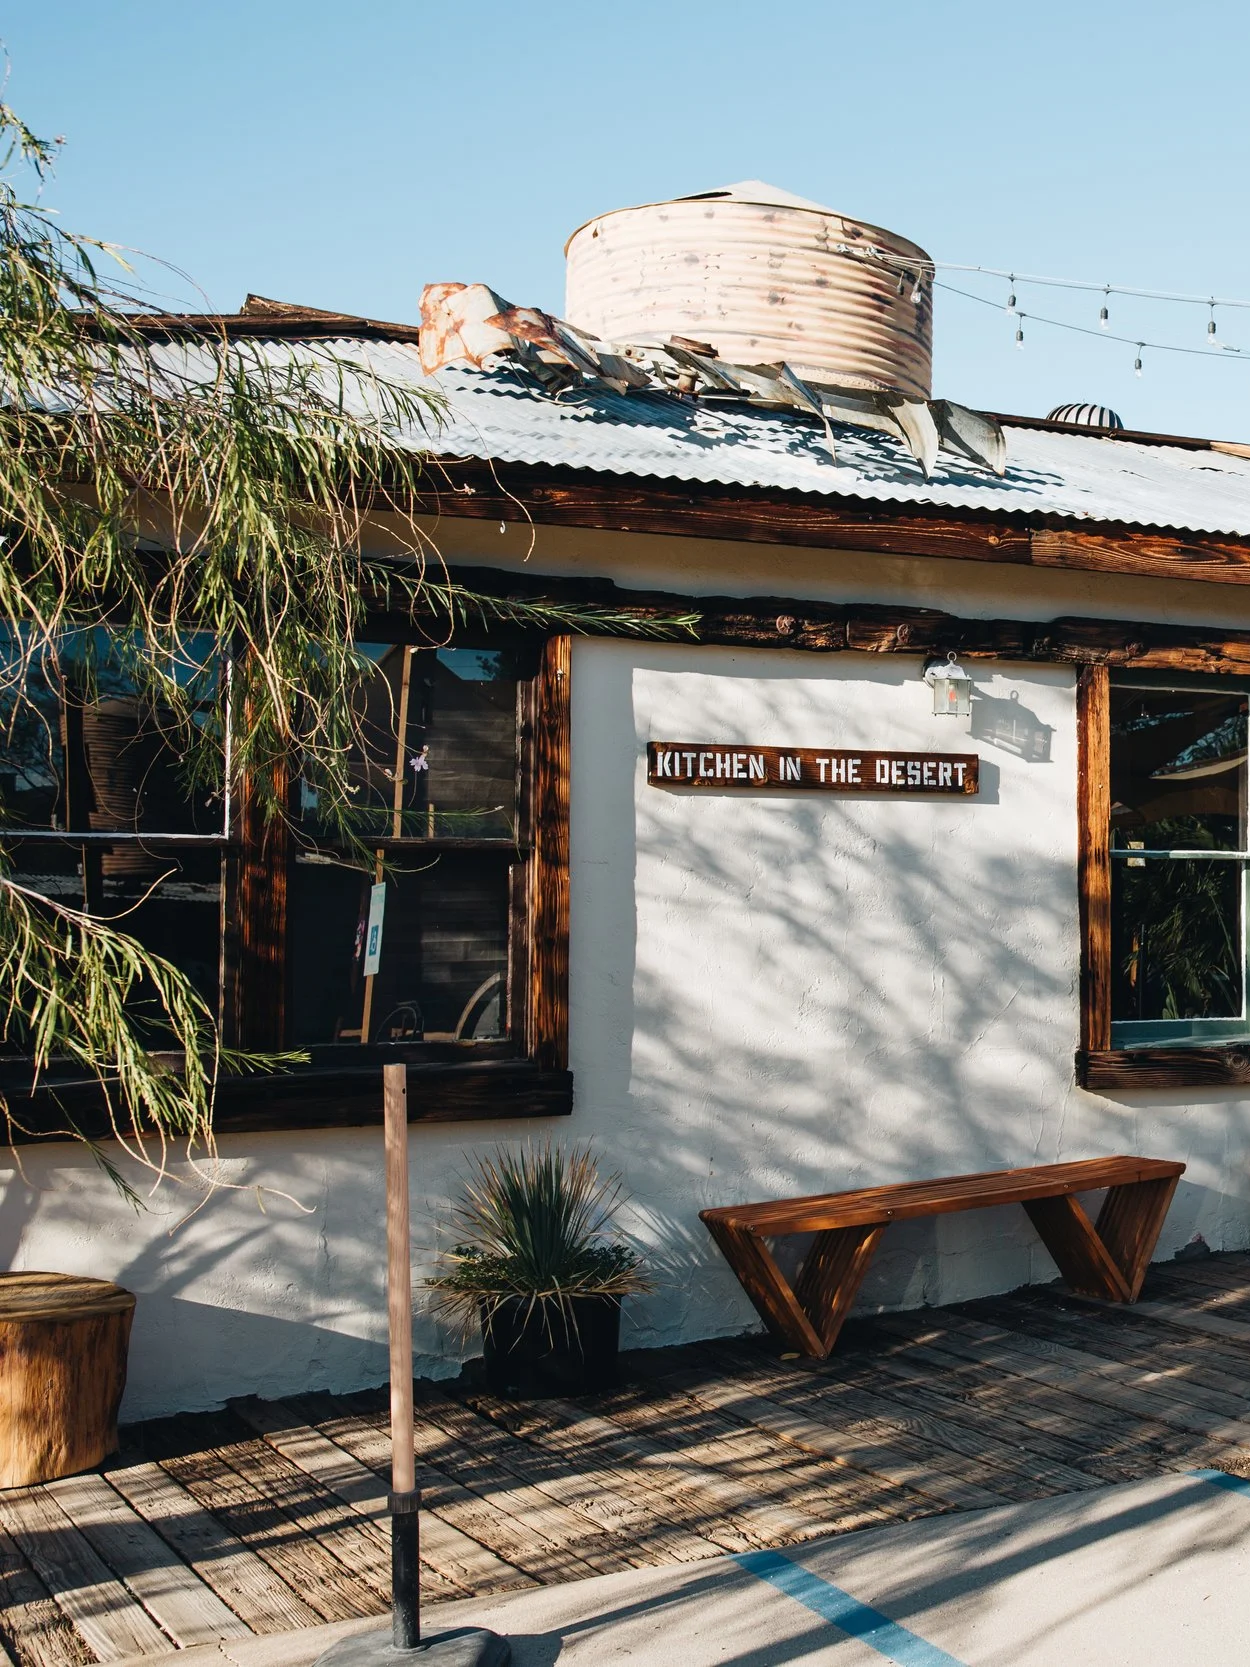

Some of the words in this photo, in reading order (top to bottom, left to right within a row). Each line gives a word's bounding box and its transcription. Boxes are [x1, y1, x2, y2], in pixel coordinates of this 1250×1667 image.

[656, 751, 765, 779] KITCHEN
[779, 756, 800, 781] IN
[815, 758, 861, 783] THE
[875, 759, 967, 787] DESERT
